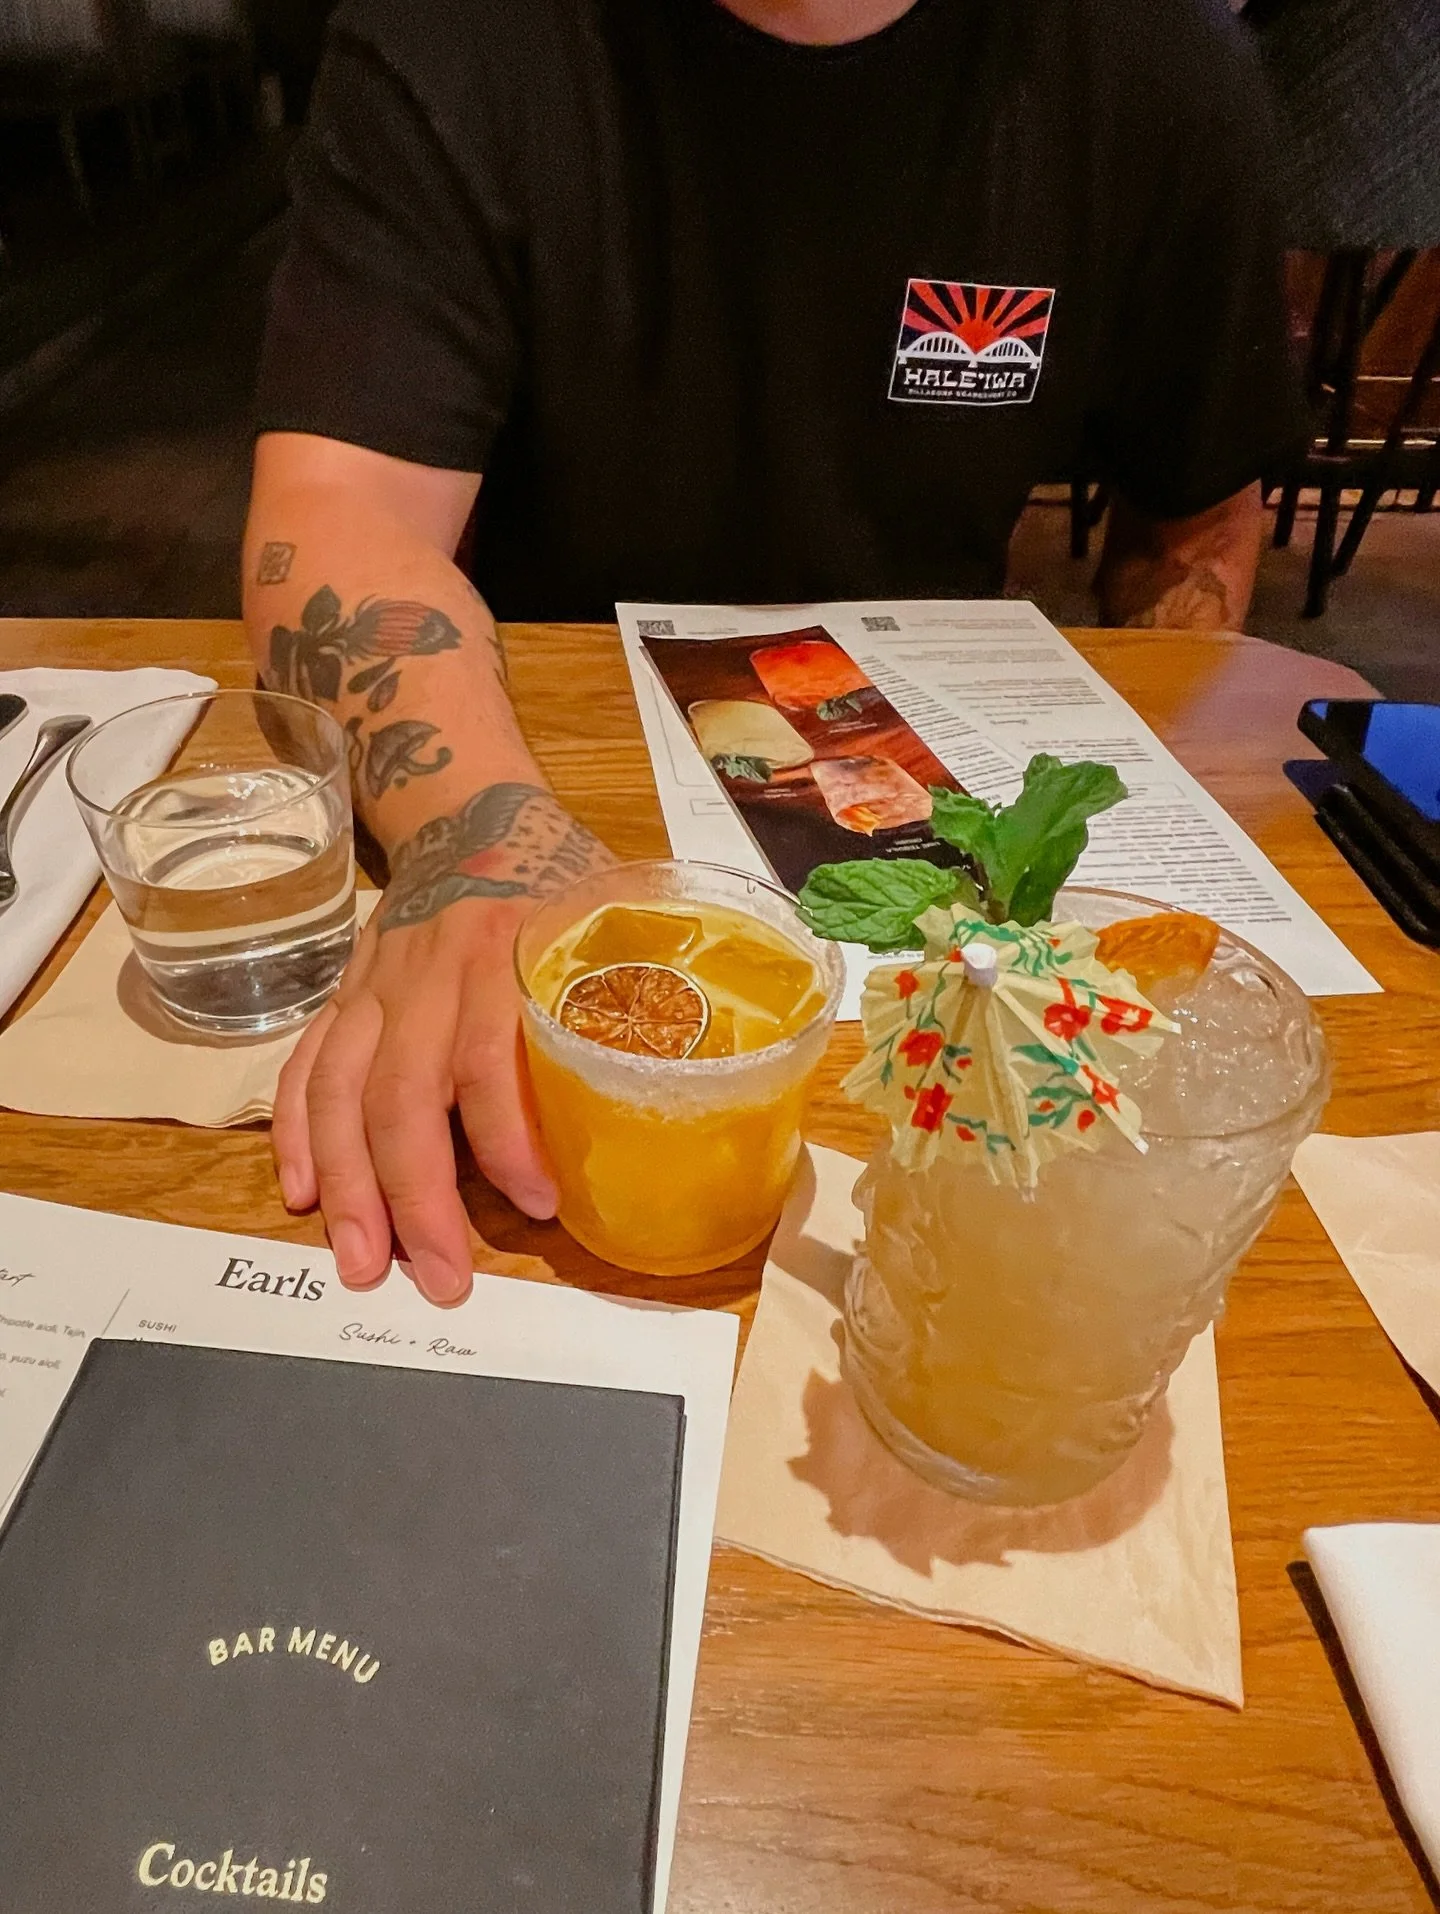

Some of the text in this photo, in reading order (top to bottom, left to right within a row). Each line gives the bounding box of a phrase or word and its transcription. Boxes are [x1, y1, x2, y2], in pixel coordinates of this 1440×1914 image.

[903, 368, 1027, 389] HALE'IWA
[214, 1257, 326, 1302] Earls
[138, 1319, 178, 1333] SUSHI
[339, 1322, 402, 1344] Sushi
[426, 1338, 477, 1356] Raw
[208, 1626, 380, 1683] BAR MENU
[138, 1842, 329, 1904] Cocktails
